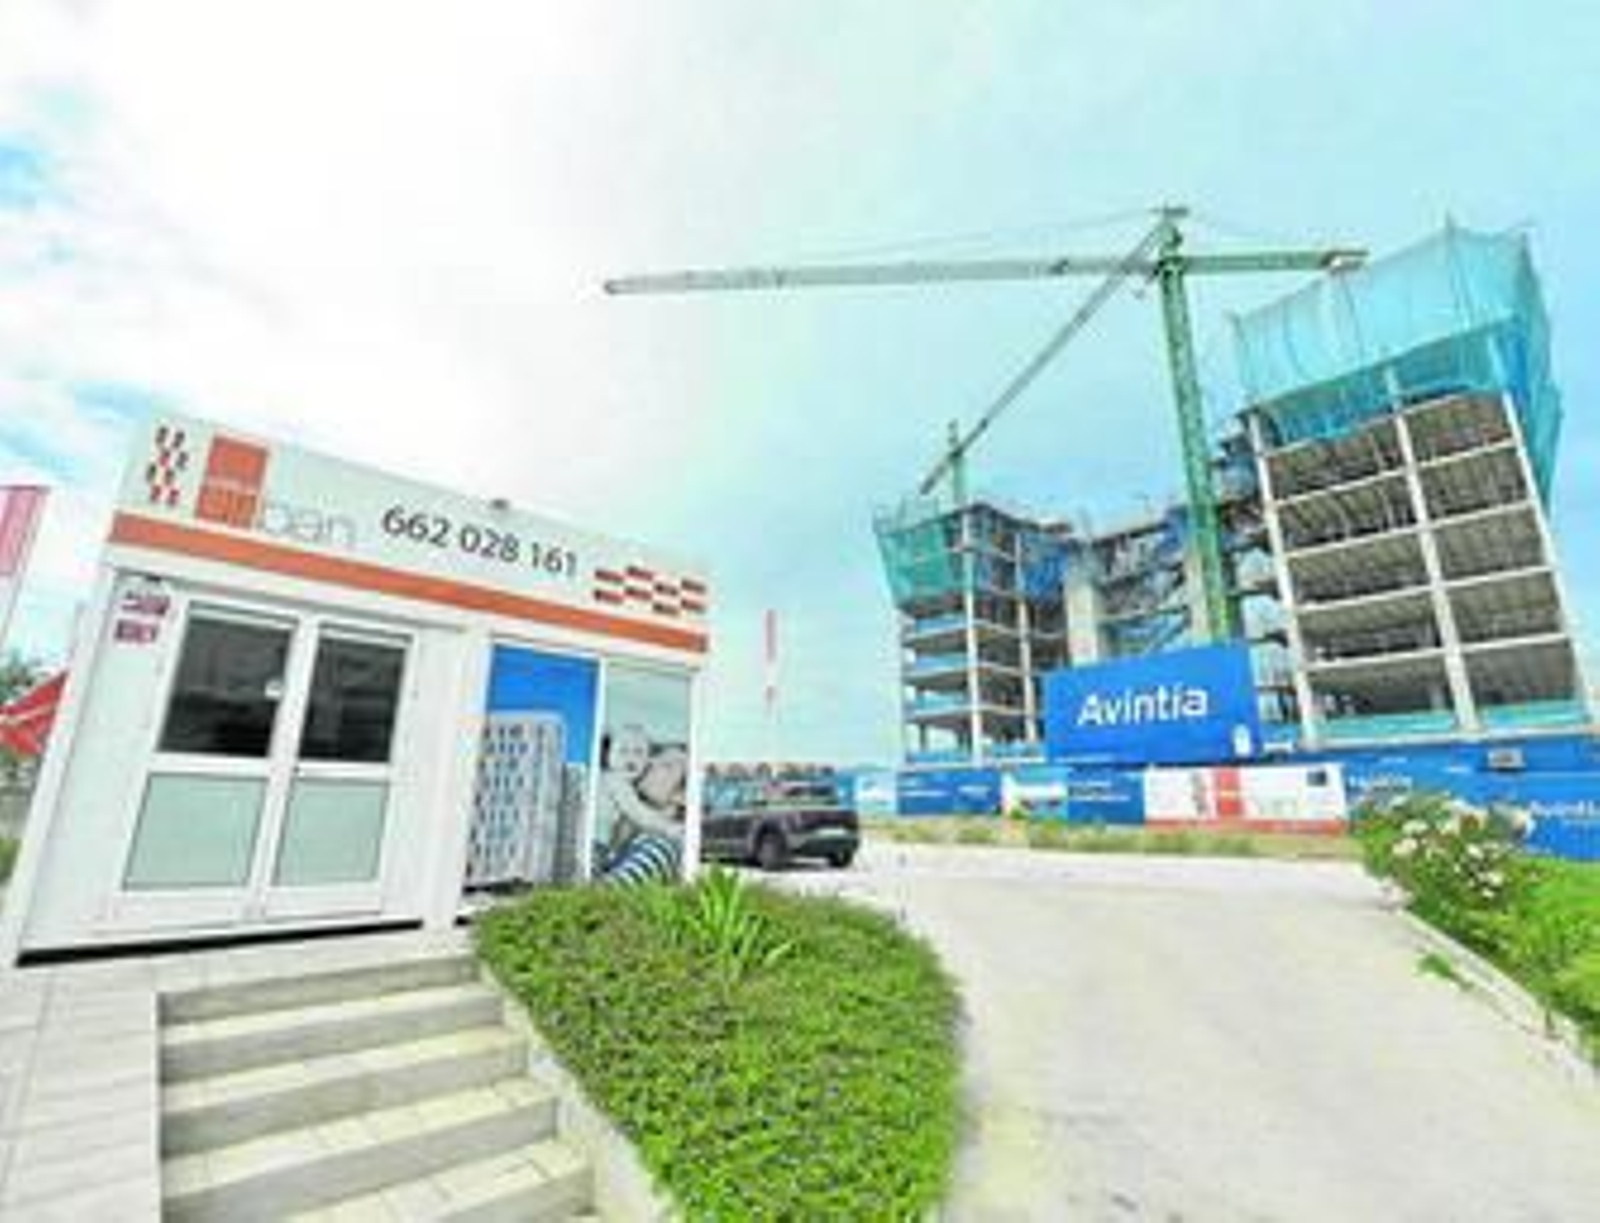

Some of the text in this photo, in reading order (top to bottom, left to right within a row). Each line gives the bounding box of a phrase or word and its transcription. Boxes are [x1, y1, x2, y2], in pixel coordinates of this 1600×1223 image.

[382, 505, 578, 577] 662 028 161
